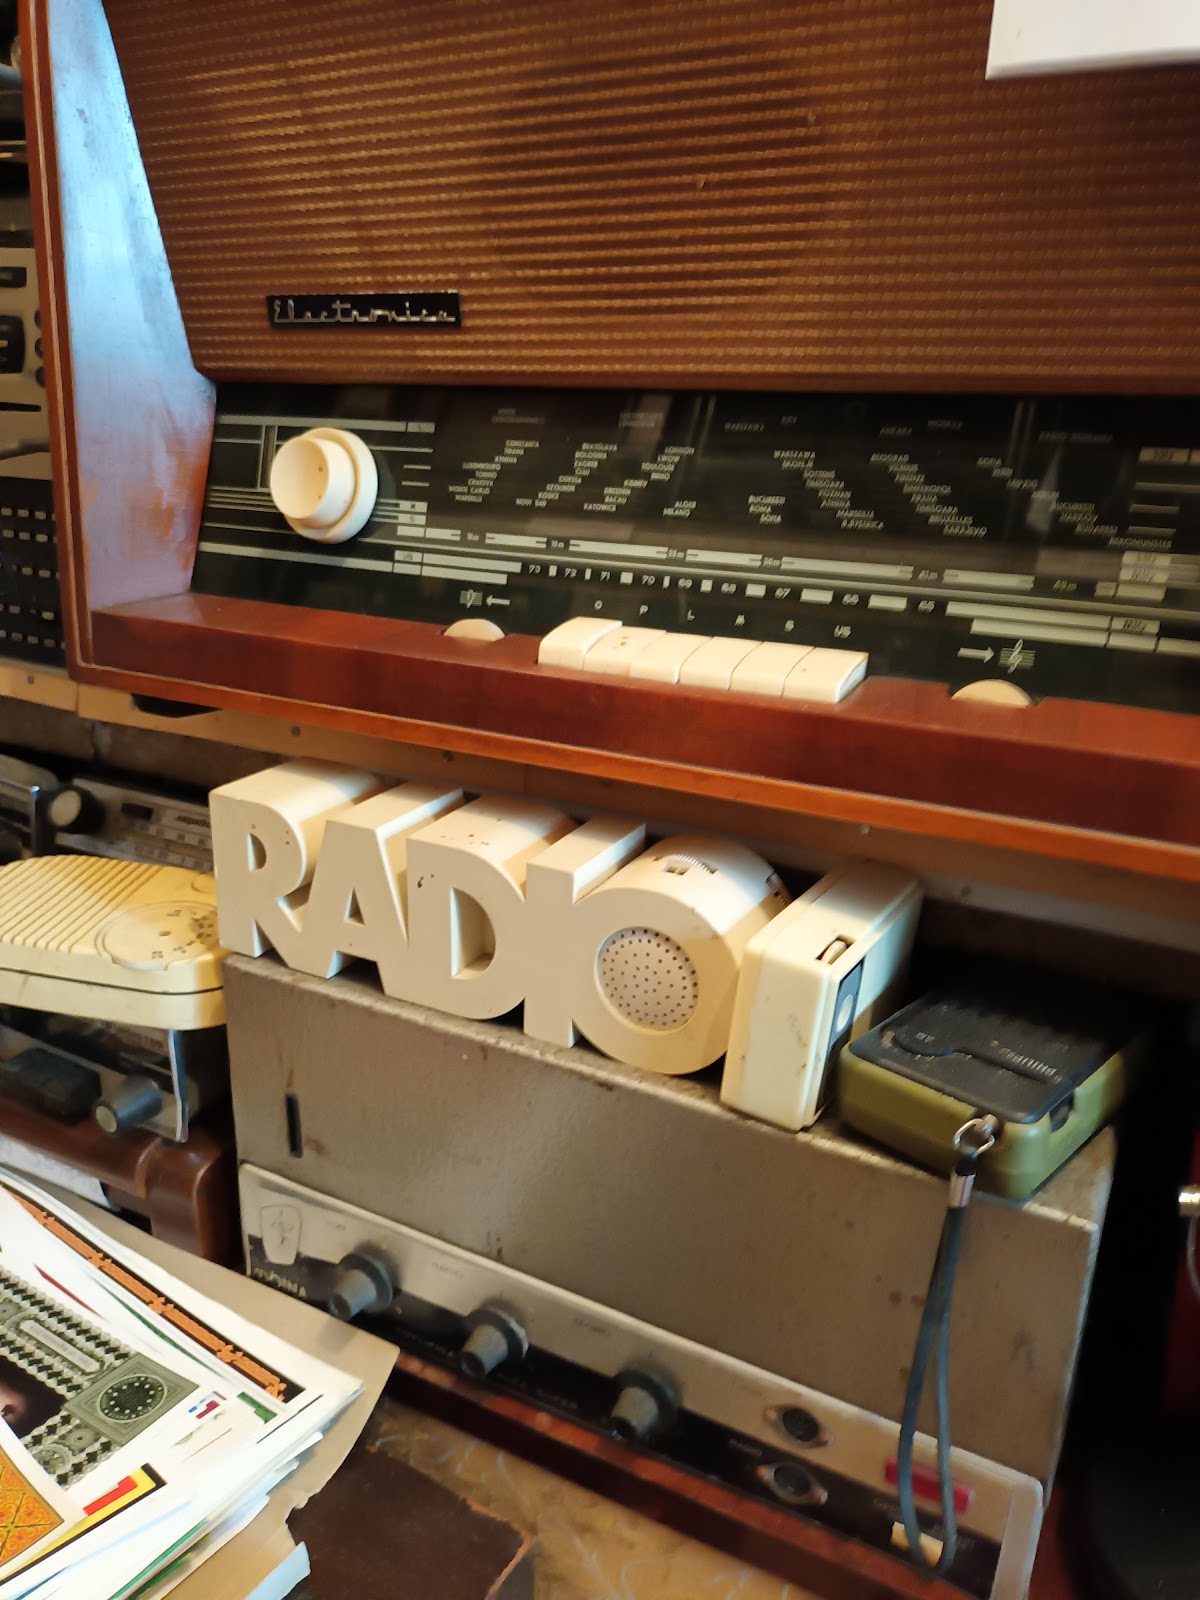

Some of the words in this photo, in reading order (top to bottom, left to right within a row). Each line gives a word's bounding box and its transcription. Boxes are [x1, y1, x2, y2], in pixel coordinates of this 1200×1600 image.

[664, 446, 695, 456] LONDON
[773, 450, 816, 460] WARSZAWA
[749, 504, 772, 514] ROMA
[528, 564, 541, 575] 73
[564, 568, 577, 578] 72
[600, 571, 611, 581] 71
[642, 575, 656, 586] 70
[678, 578, 693, 589] 69
[775, 587, 791, 599] 67
[687, 610, 695, 621] L
[208, 772, 755, 1077] RADIO
